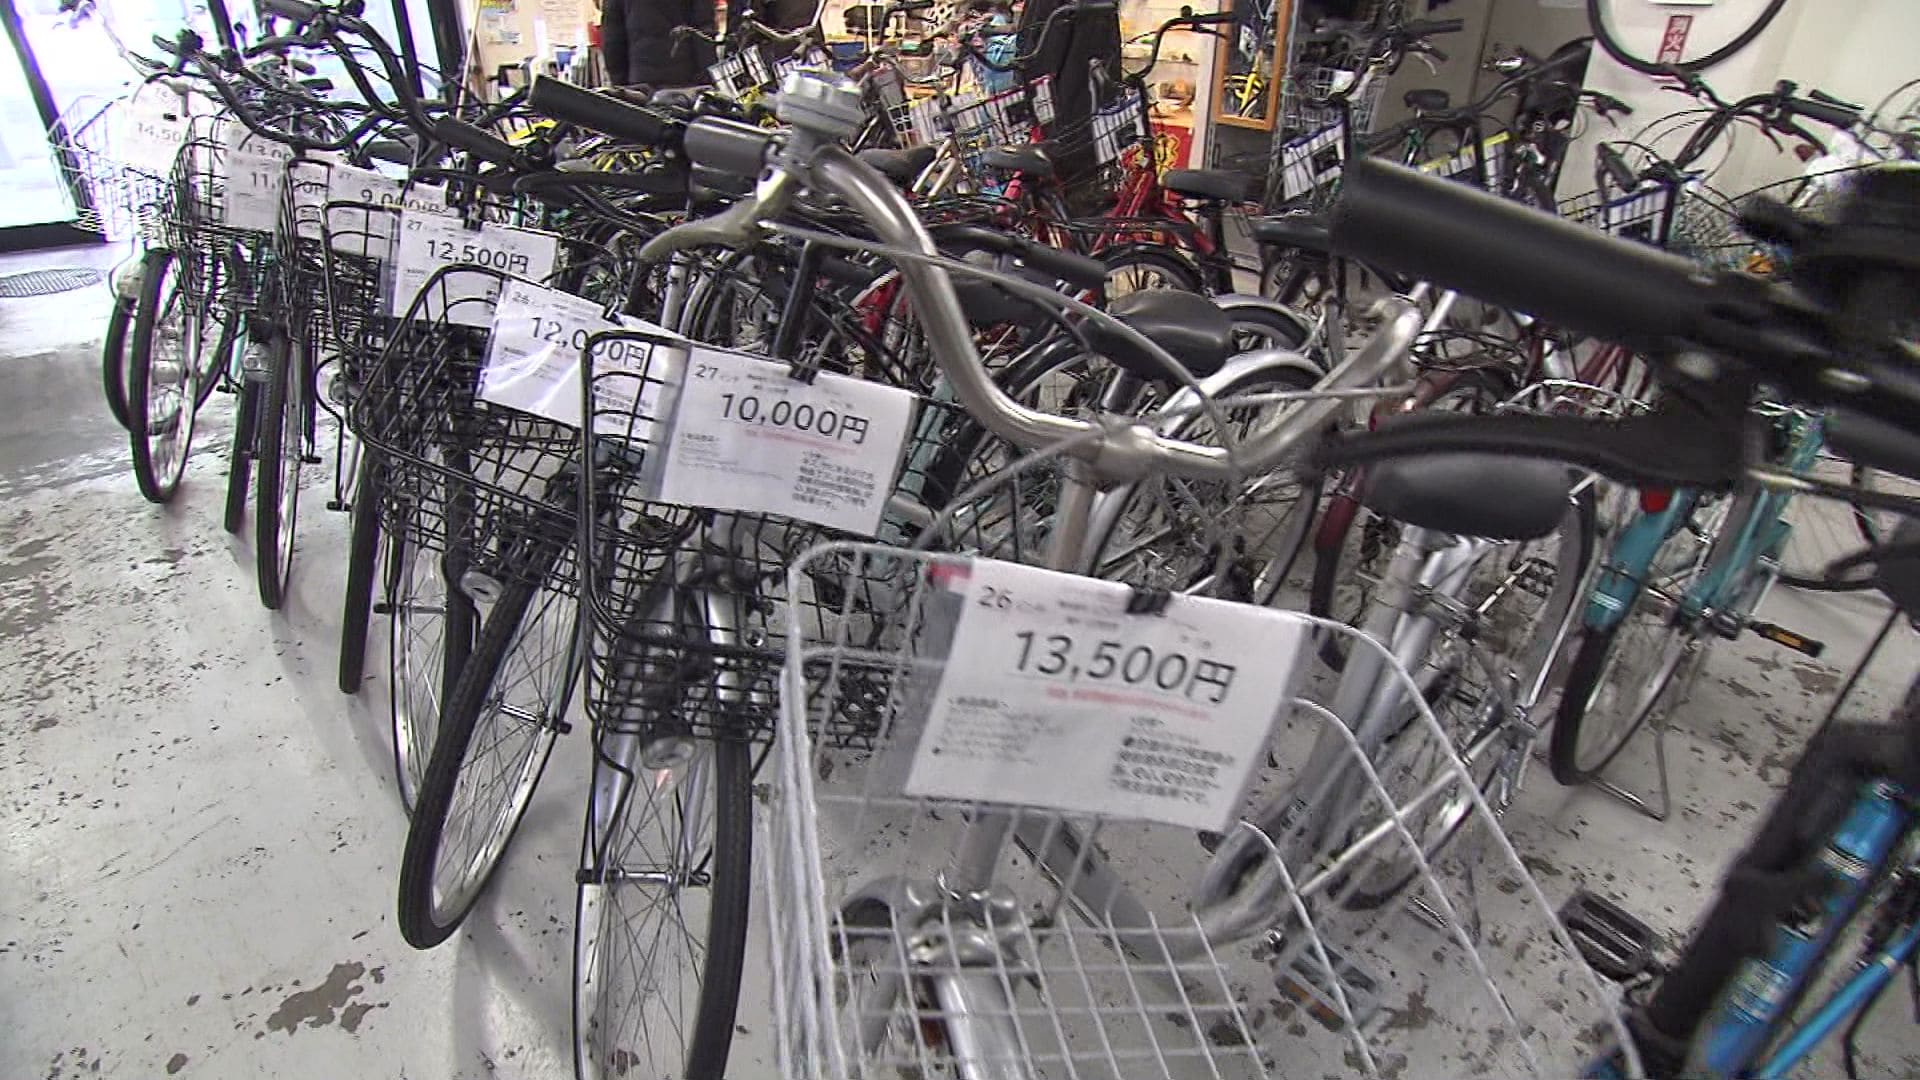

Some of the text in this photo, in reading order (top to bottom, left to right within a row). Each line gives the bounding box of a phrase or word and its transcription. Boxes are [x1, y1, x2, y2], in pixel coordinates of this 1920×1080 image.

[138, 123, 182, 142] 14,50
[407, 219, 423, 231] 27
[427, 240, 529, 275] 12,500円
[694, 363, 719, 379] 27
[721, 393, 870, 445] 10,000円
[978, 586, 1013, 609] 26
[1016, 631, 1237, 703] 13,500円
